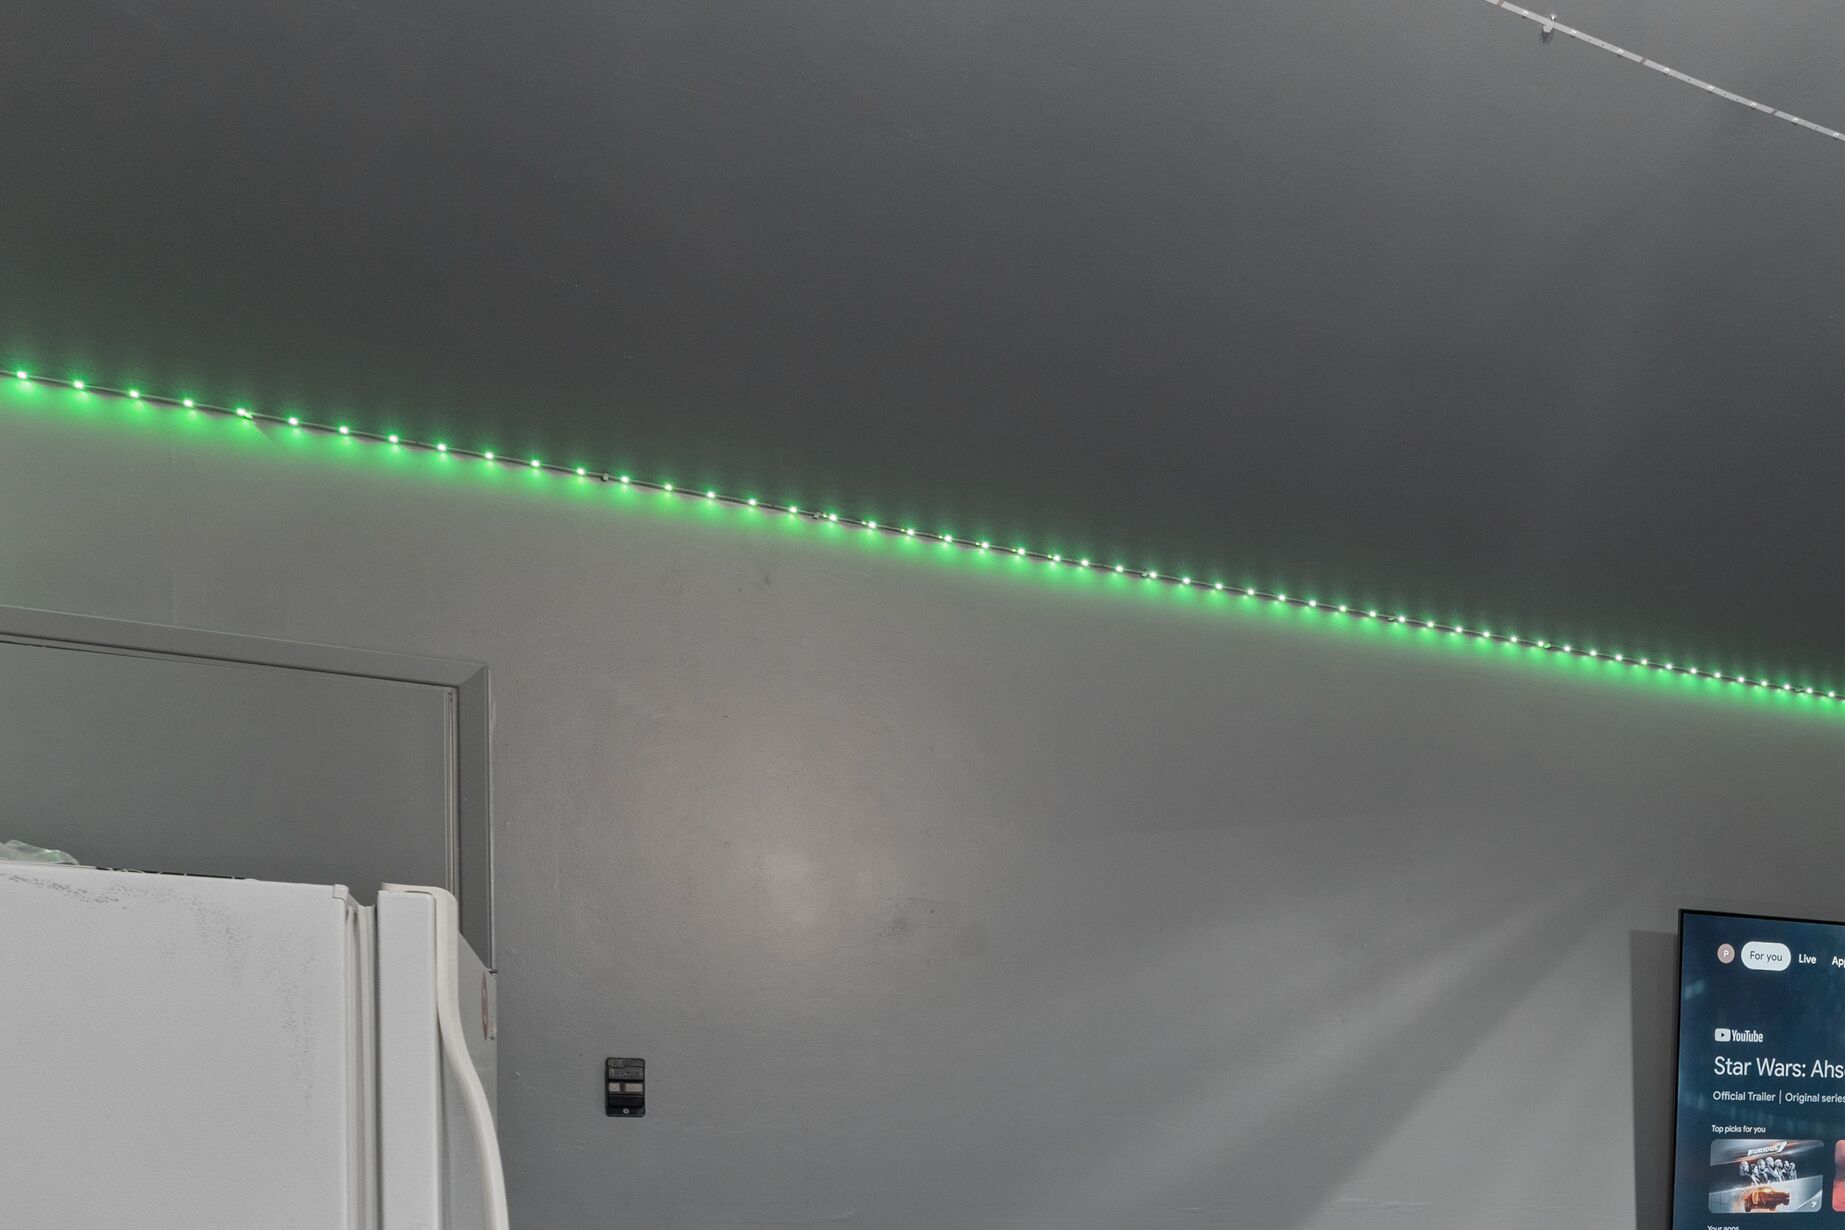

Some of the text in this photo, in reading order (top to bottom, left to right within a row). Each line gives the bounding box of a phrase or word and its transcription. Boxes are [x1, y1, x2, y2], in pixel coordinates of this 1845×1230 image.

[1750, 951, 1782, 962] For you
[1798, 954, 1816, 964] Live
[1732, 1030, 1764, 1042] YouTube
[1714, 1055, 1752, 1076] Star
[1756, 1057, 1806, 1078] Wars:
[1712, 1090, 1746, 1101] Official
[1748, 1091, 1776, 1102] Trailer
[1785, 1092, 1820, 1104] Original
[1712, 1124, 1724, 1134] Top
[1724, 1124, 1742, 1134] picks
[1754, 1126, 1766, 1134] you
